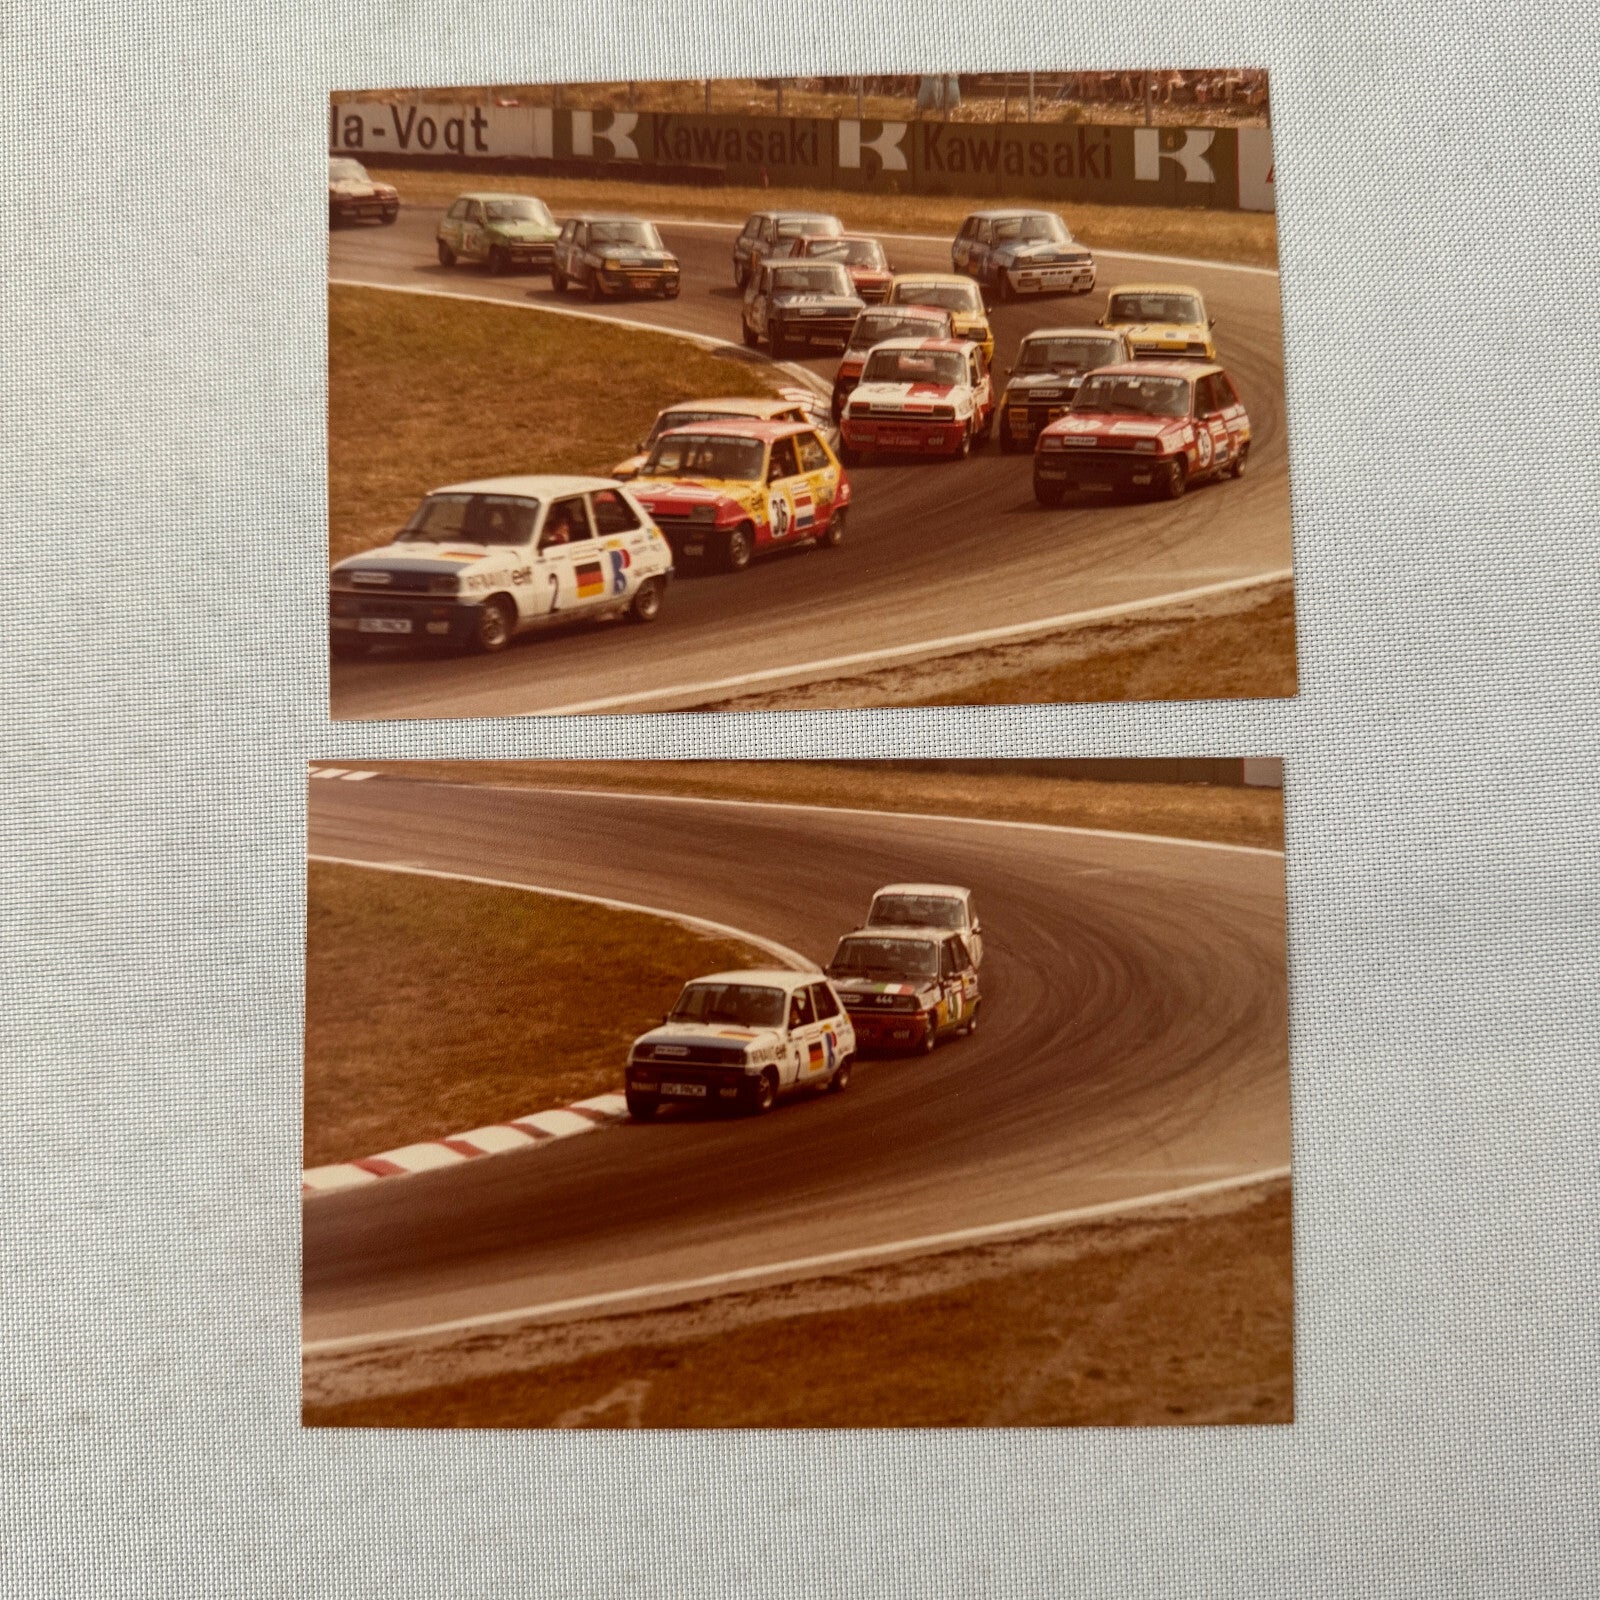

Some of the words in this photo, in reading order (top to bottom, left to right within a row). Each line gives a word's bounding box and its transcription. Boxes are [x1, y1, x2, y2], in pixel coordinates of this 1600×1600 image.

[653, 112, 818, 167] Kawasaki
[923, 123, 1112, 179] Kawasaki
[548, 573, 560, 614] 2
